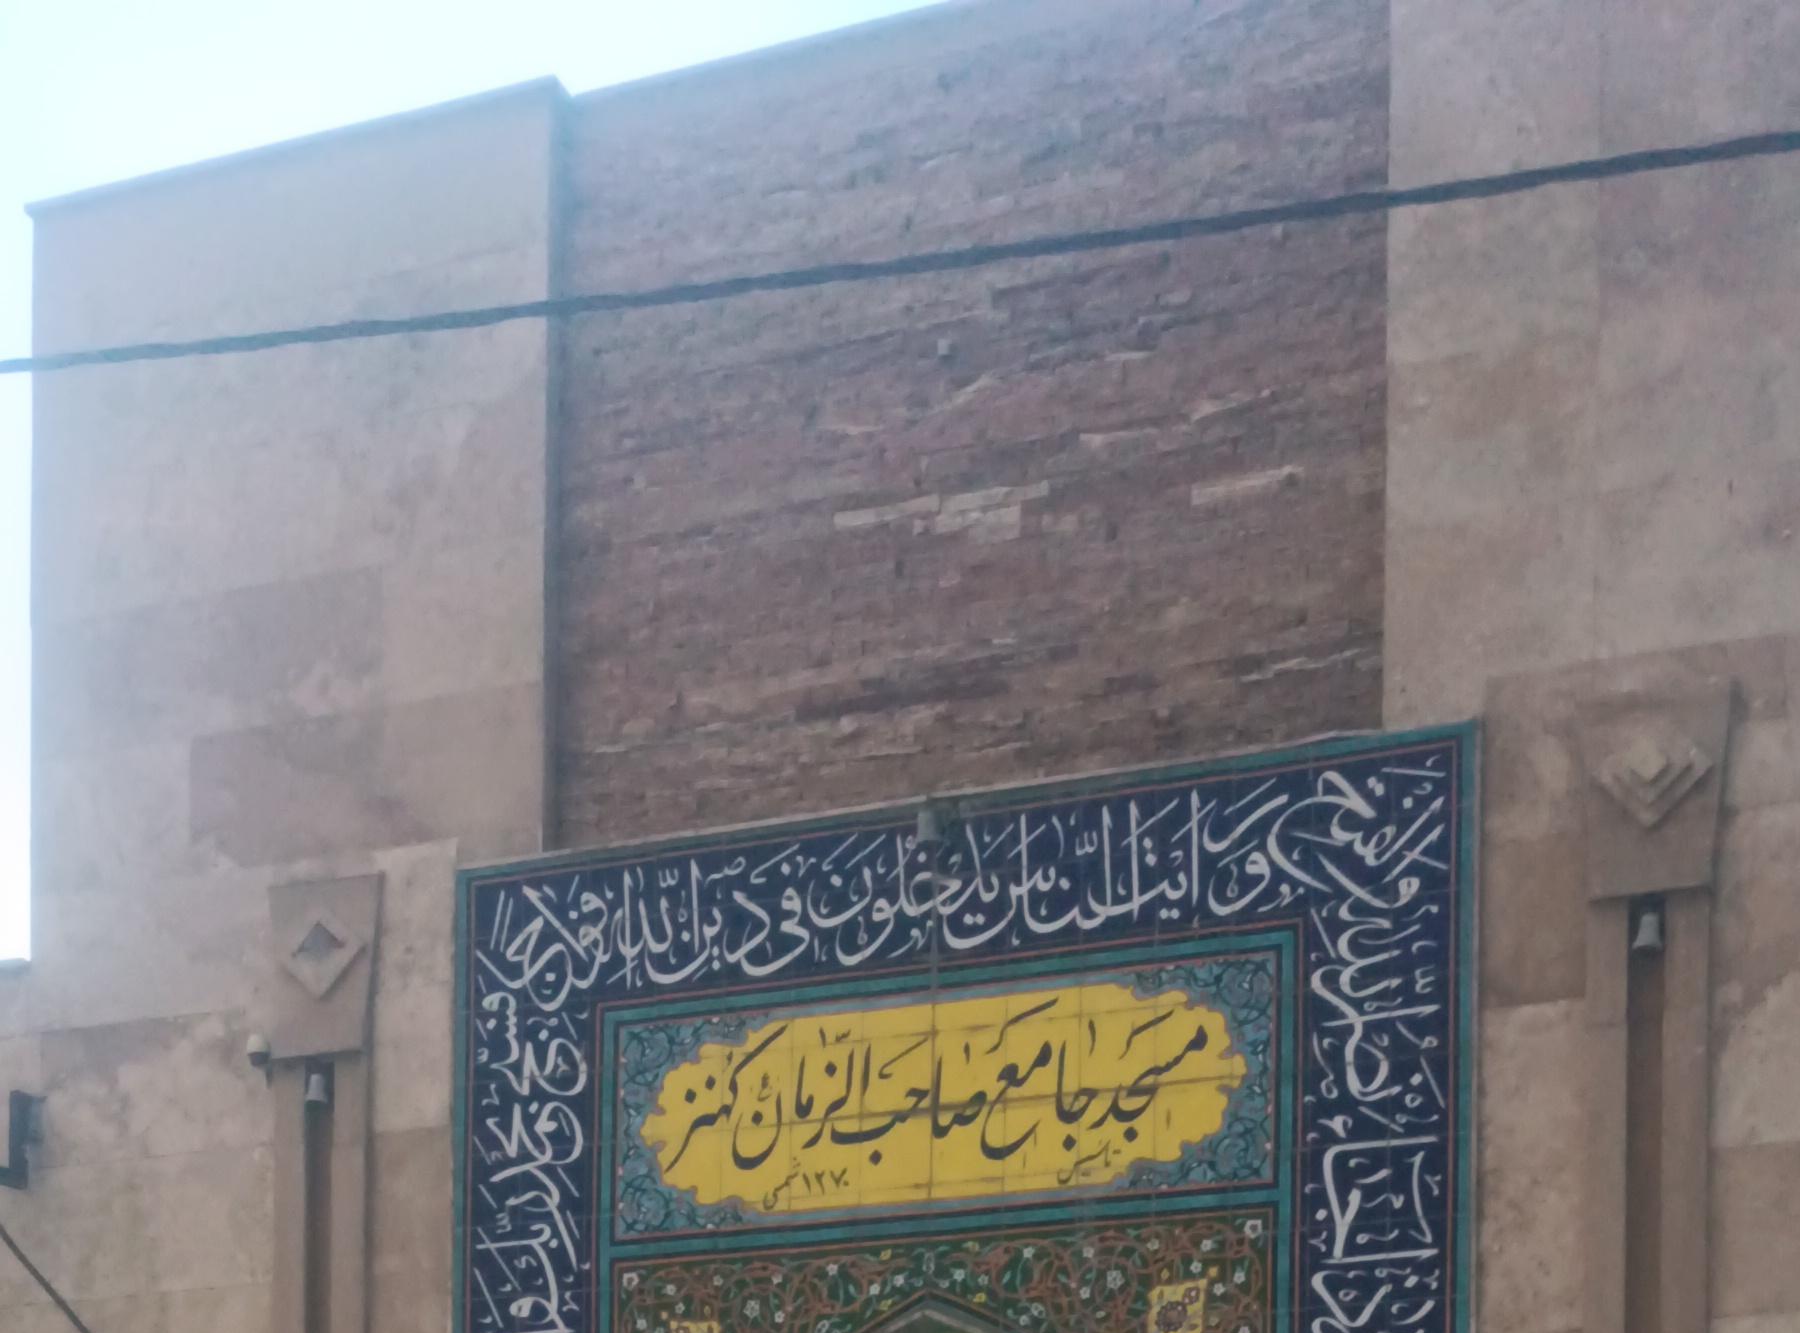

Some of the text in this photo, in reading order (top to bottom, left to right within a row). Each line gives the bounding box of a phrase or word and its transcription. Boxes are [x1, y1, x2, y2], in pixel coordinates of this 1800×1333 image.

[732, 1040, 872, 1170] الزمان
[830, 1054, 988, 1165] صاحب
[980, 1036, 1098, 1161] جامع
[1086, 1022, 1208, 1143] مسجد
